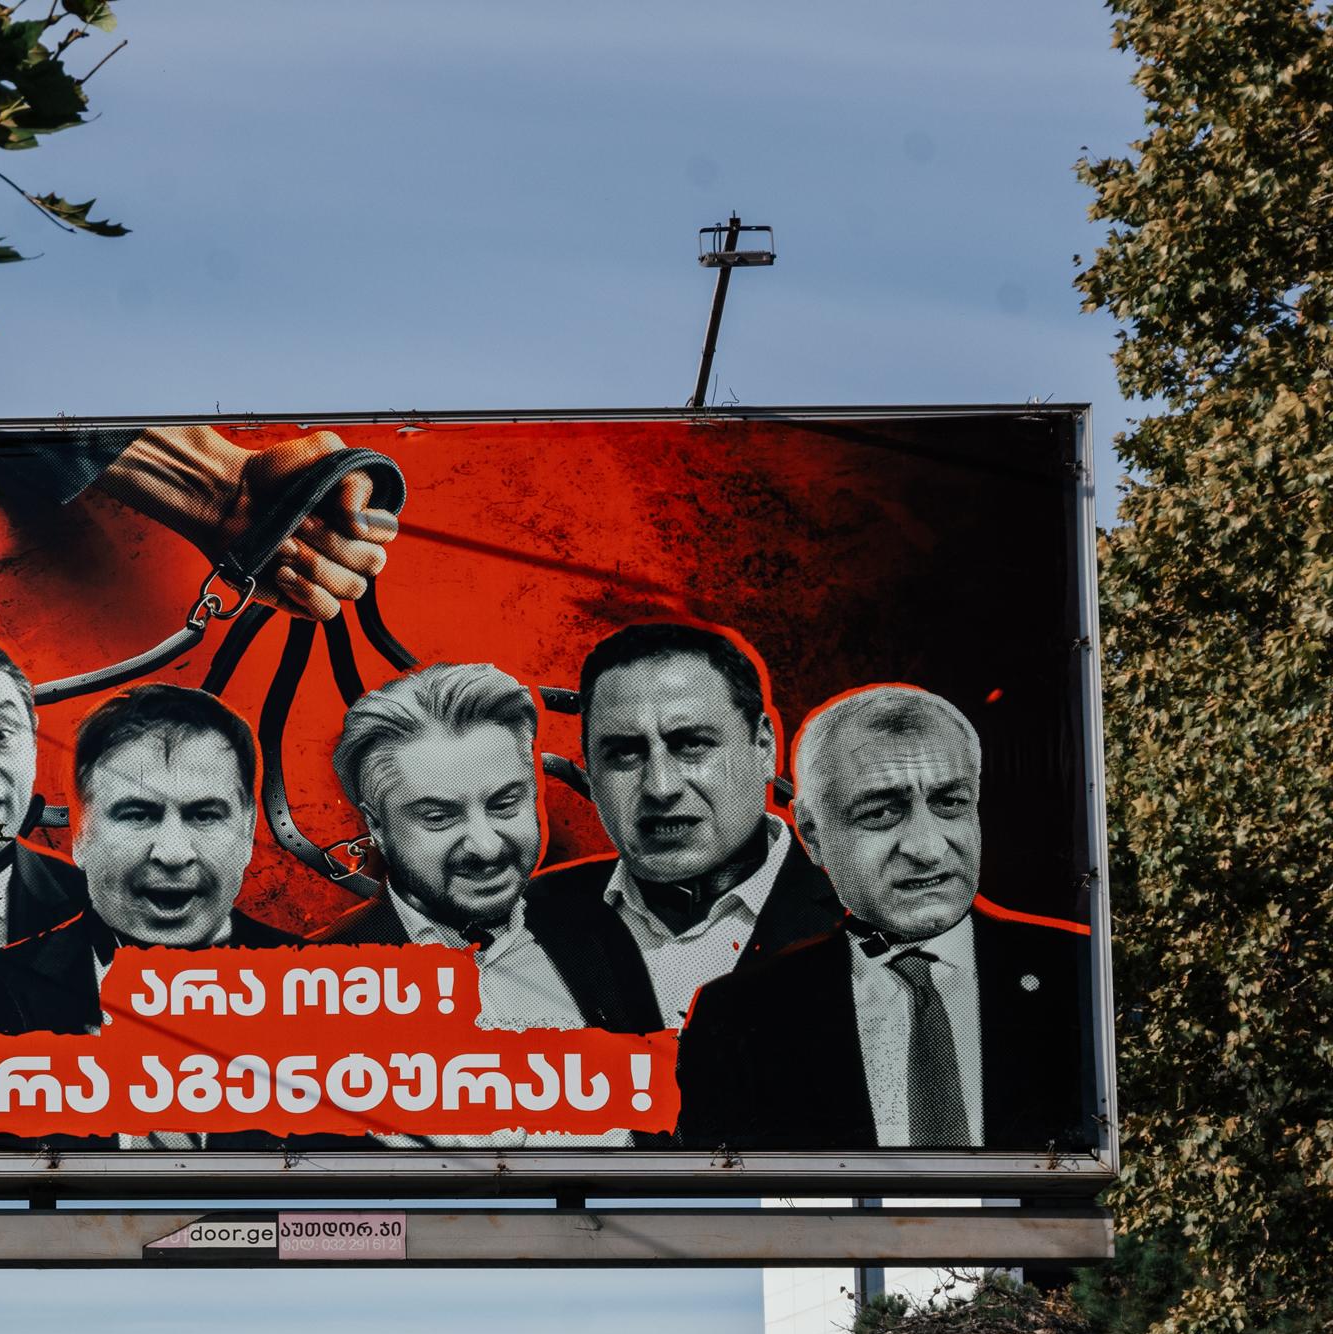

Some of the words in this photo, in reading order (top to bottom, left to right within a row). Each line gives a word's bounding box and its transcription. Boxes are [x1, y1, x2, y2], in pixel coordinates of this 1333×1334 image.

[130, 968, 267, 1017] არა
[282, 966, 422, 1016] ომს
[128, 1052, 611, 1114] აგენტურას
